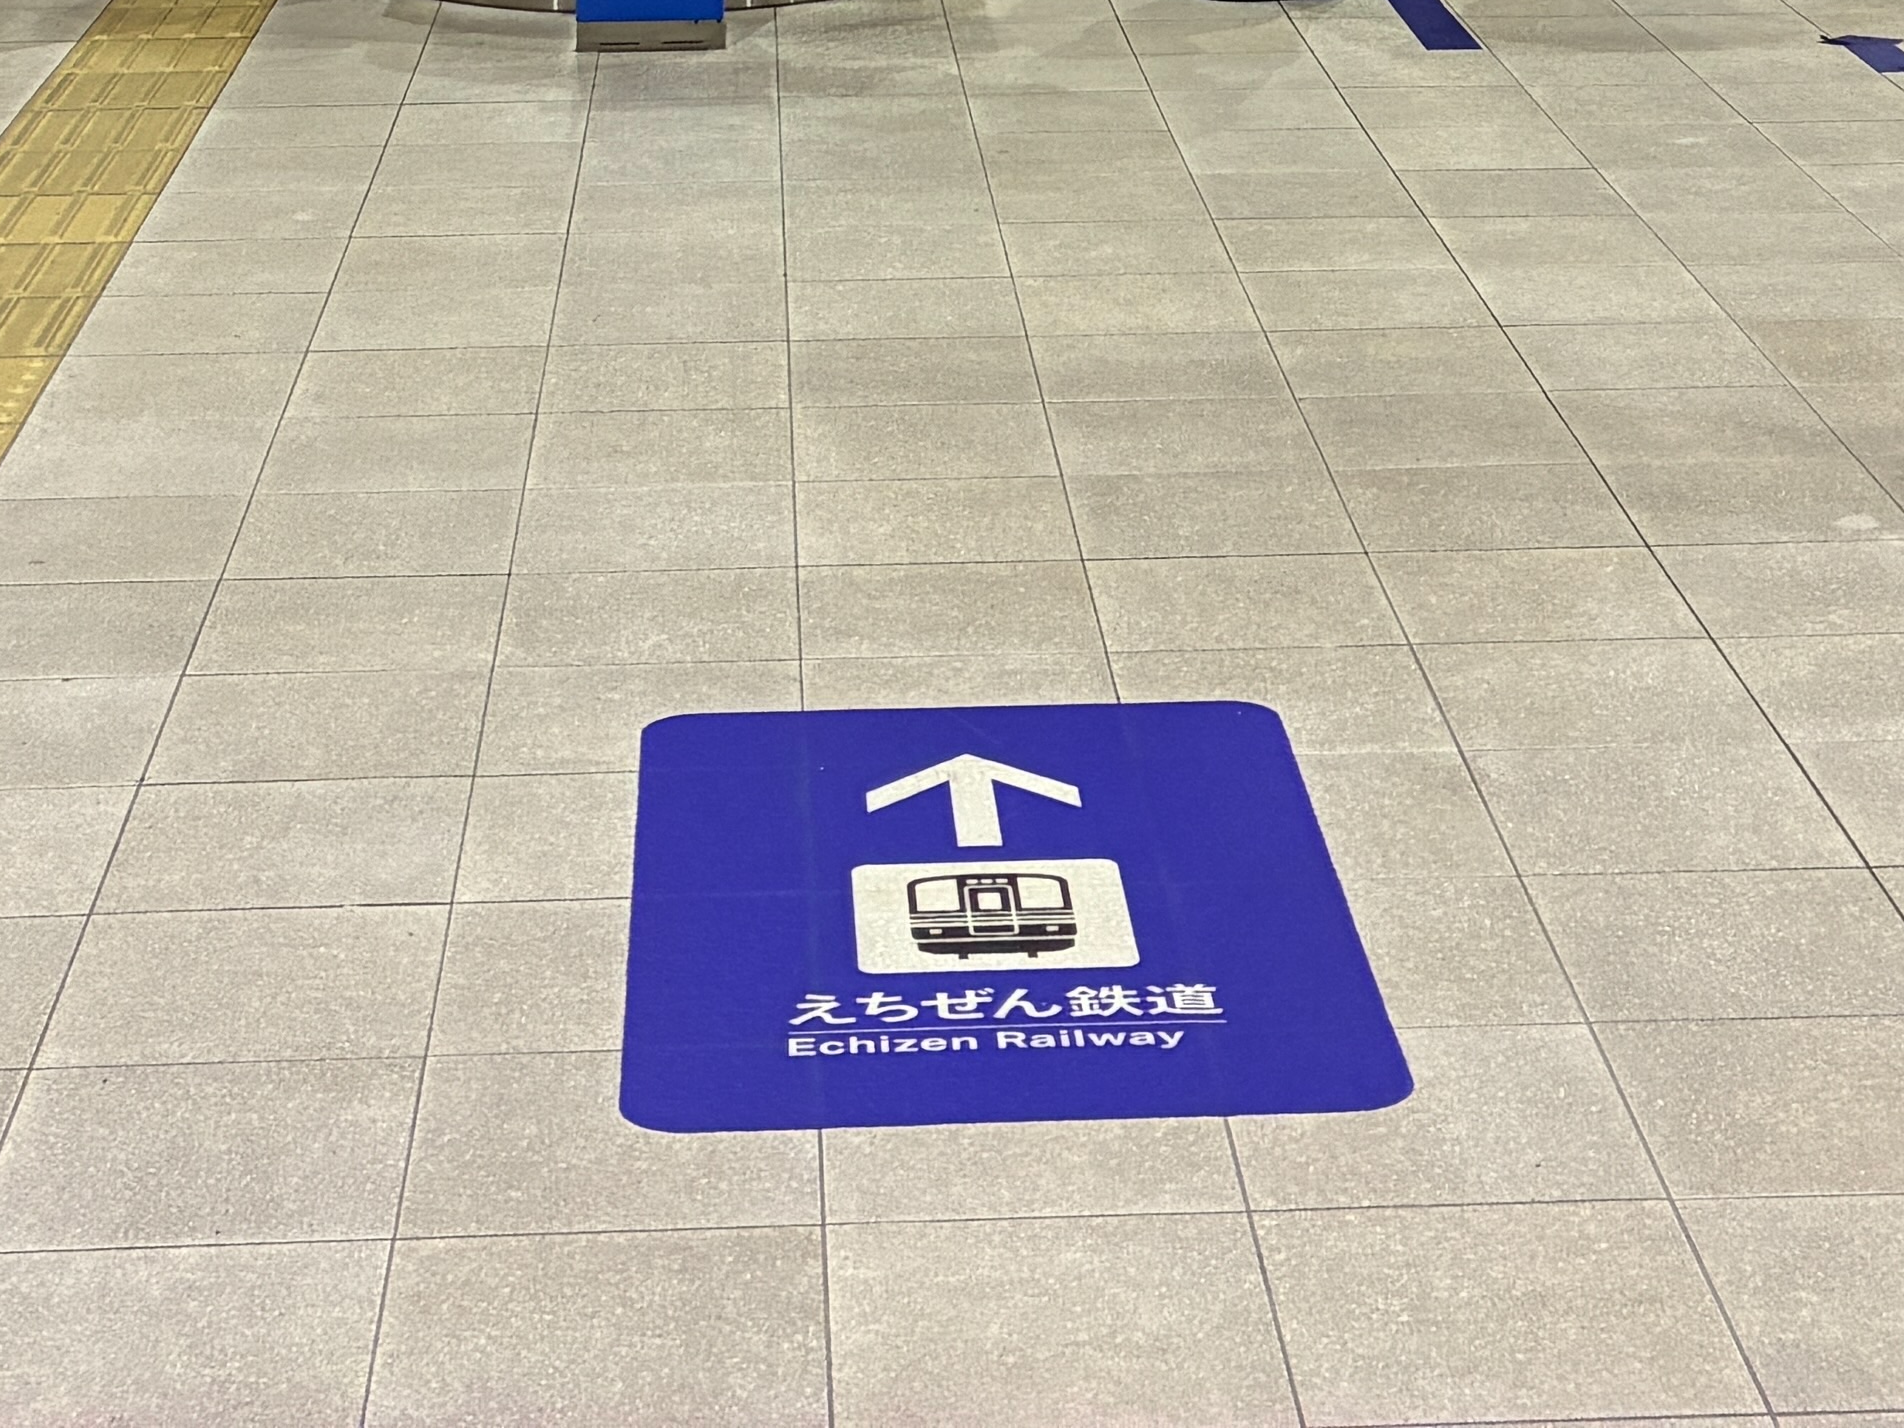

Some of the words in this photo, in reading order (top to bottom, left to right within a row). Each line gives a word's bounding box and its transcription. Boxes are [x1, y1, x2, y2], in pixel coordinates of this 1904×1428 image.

[790, 983, 1225, 1026] えちぜん鉄道
[786, 1032, 978, 1059] Echizen
[994, 1026, 1185, 1054] Railway
